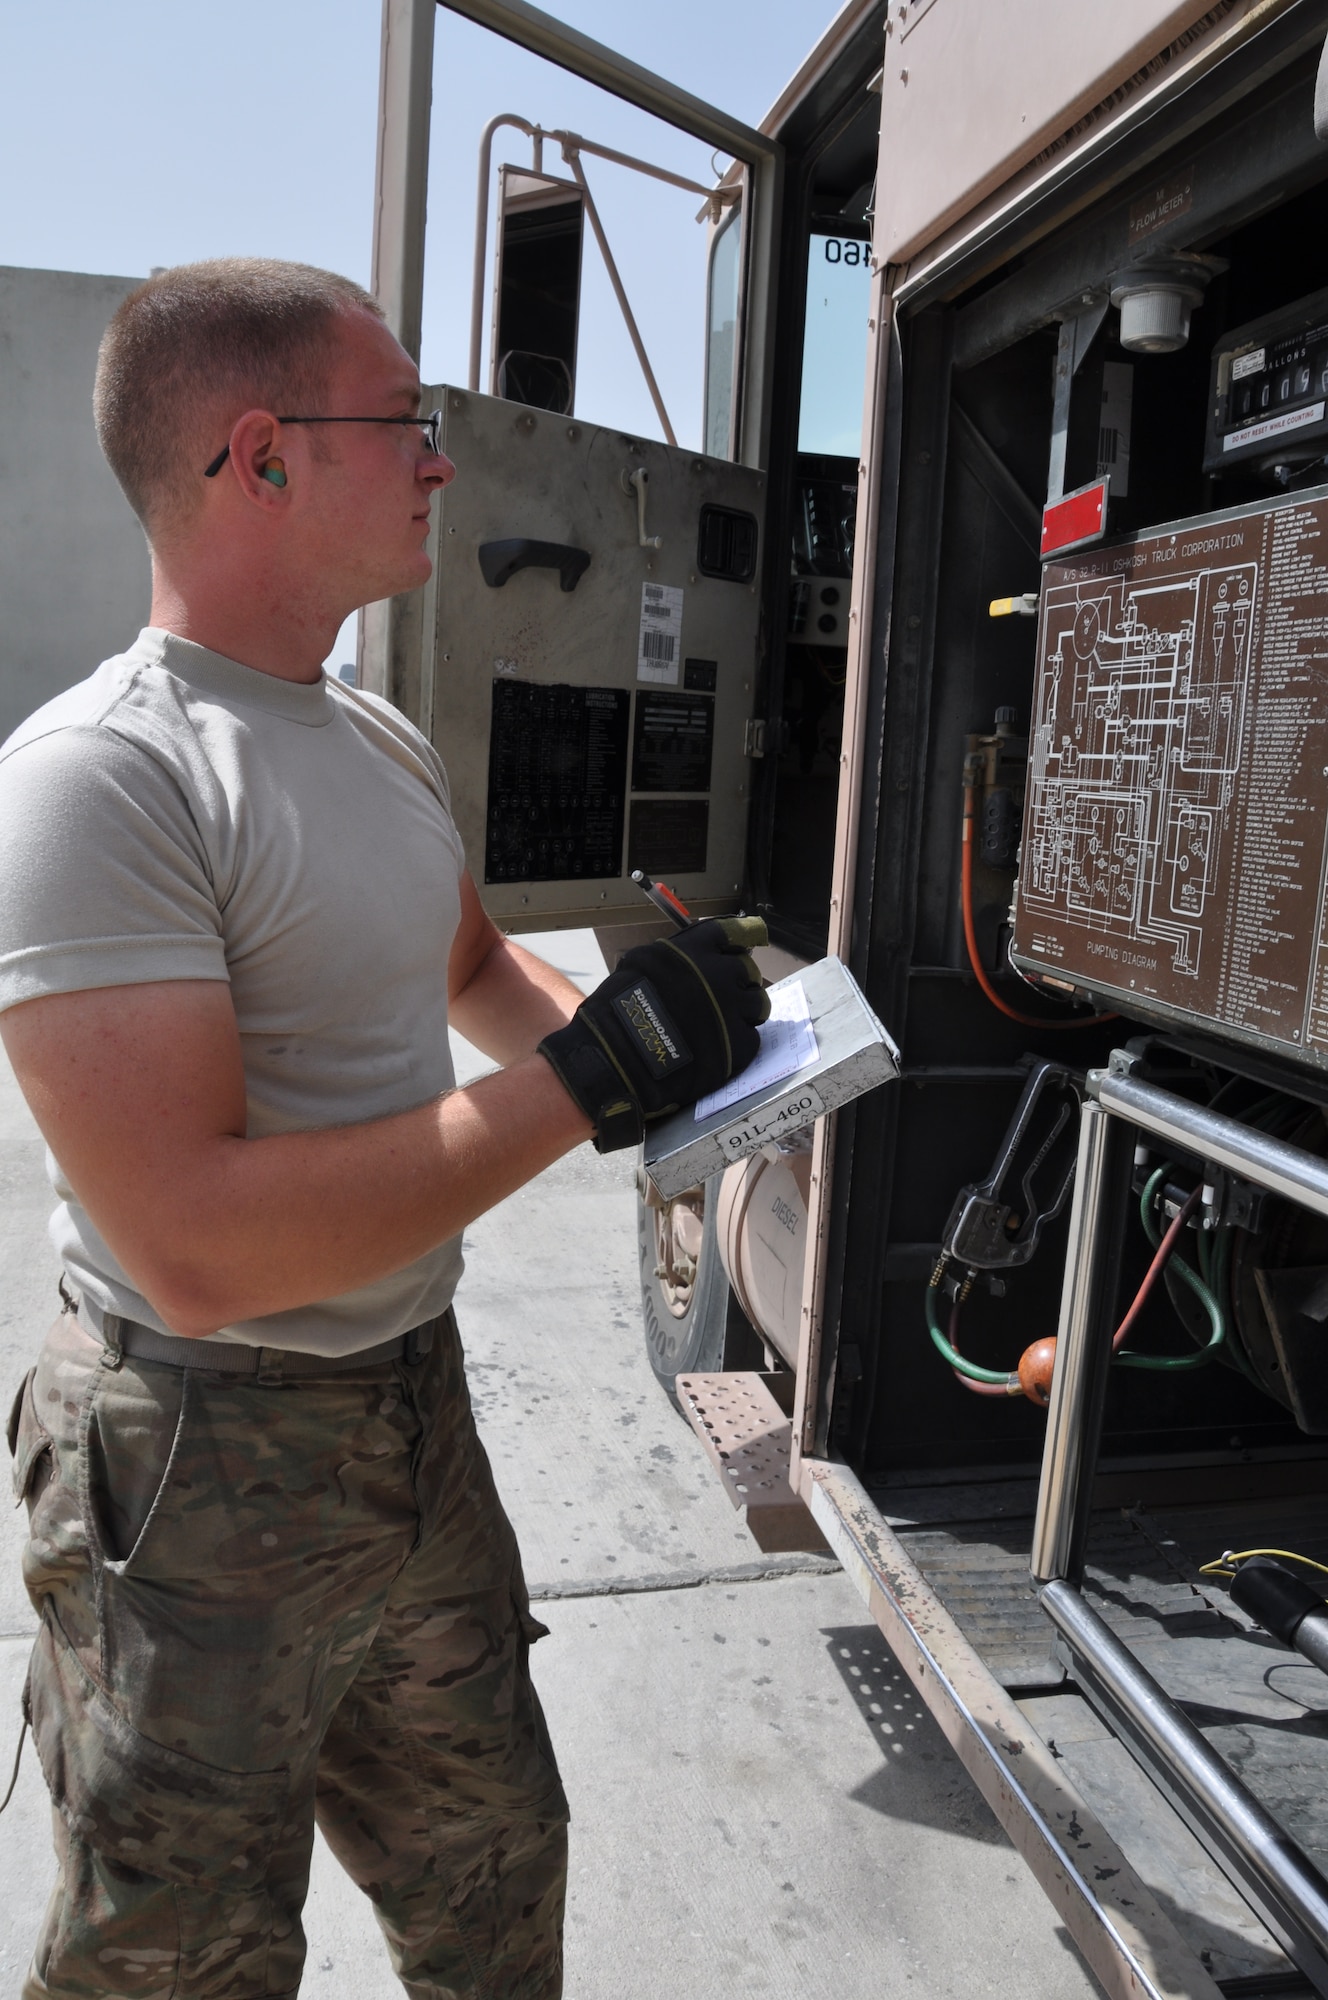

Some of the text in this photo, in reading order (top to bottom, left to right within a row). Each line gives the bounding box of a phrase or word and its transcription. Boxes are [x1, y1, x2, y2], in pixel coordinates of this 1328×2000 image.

[1136, 209, 1157, 232] FLOW
[1158, 193, 1183, 217] METER
[1232, 409, 1314, 444] DO NOT RESET WHILE COUNTING
[1113, 554, 1148, 572] OSHKOSH
[1152, 547, 1177, 564] TRUCK
[1181, 533, 1244, 557] CORPORATION
[1087, 941, 1119, 960] PUMPING
[1121, 951, 1157, 971] DIAGRAM
[633, 987, 680, 1060] PERFORMANCE
[729, 1097, 813, 1149] 91L-460
[771, 1196, 799, 1236] DIESEL
